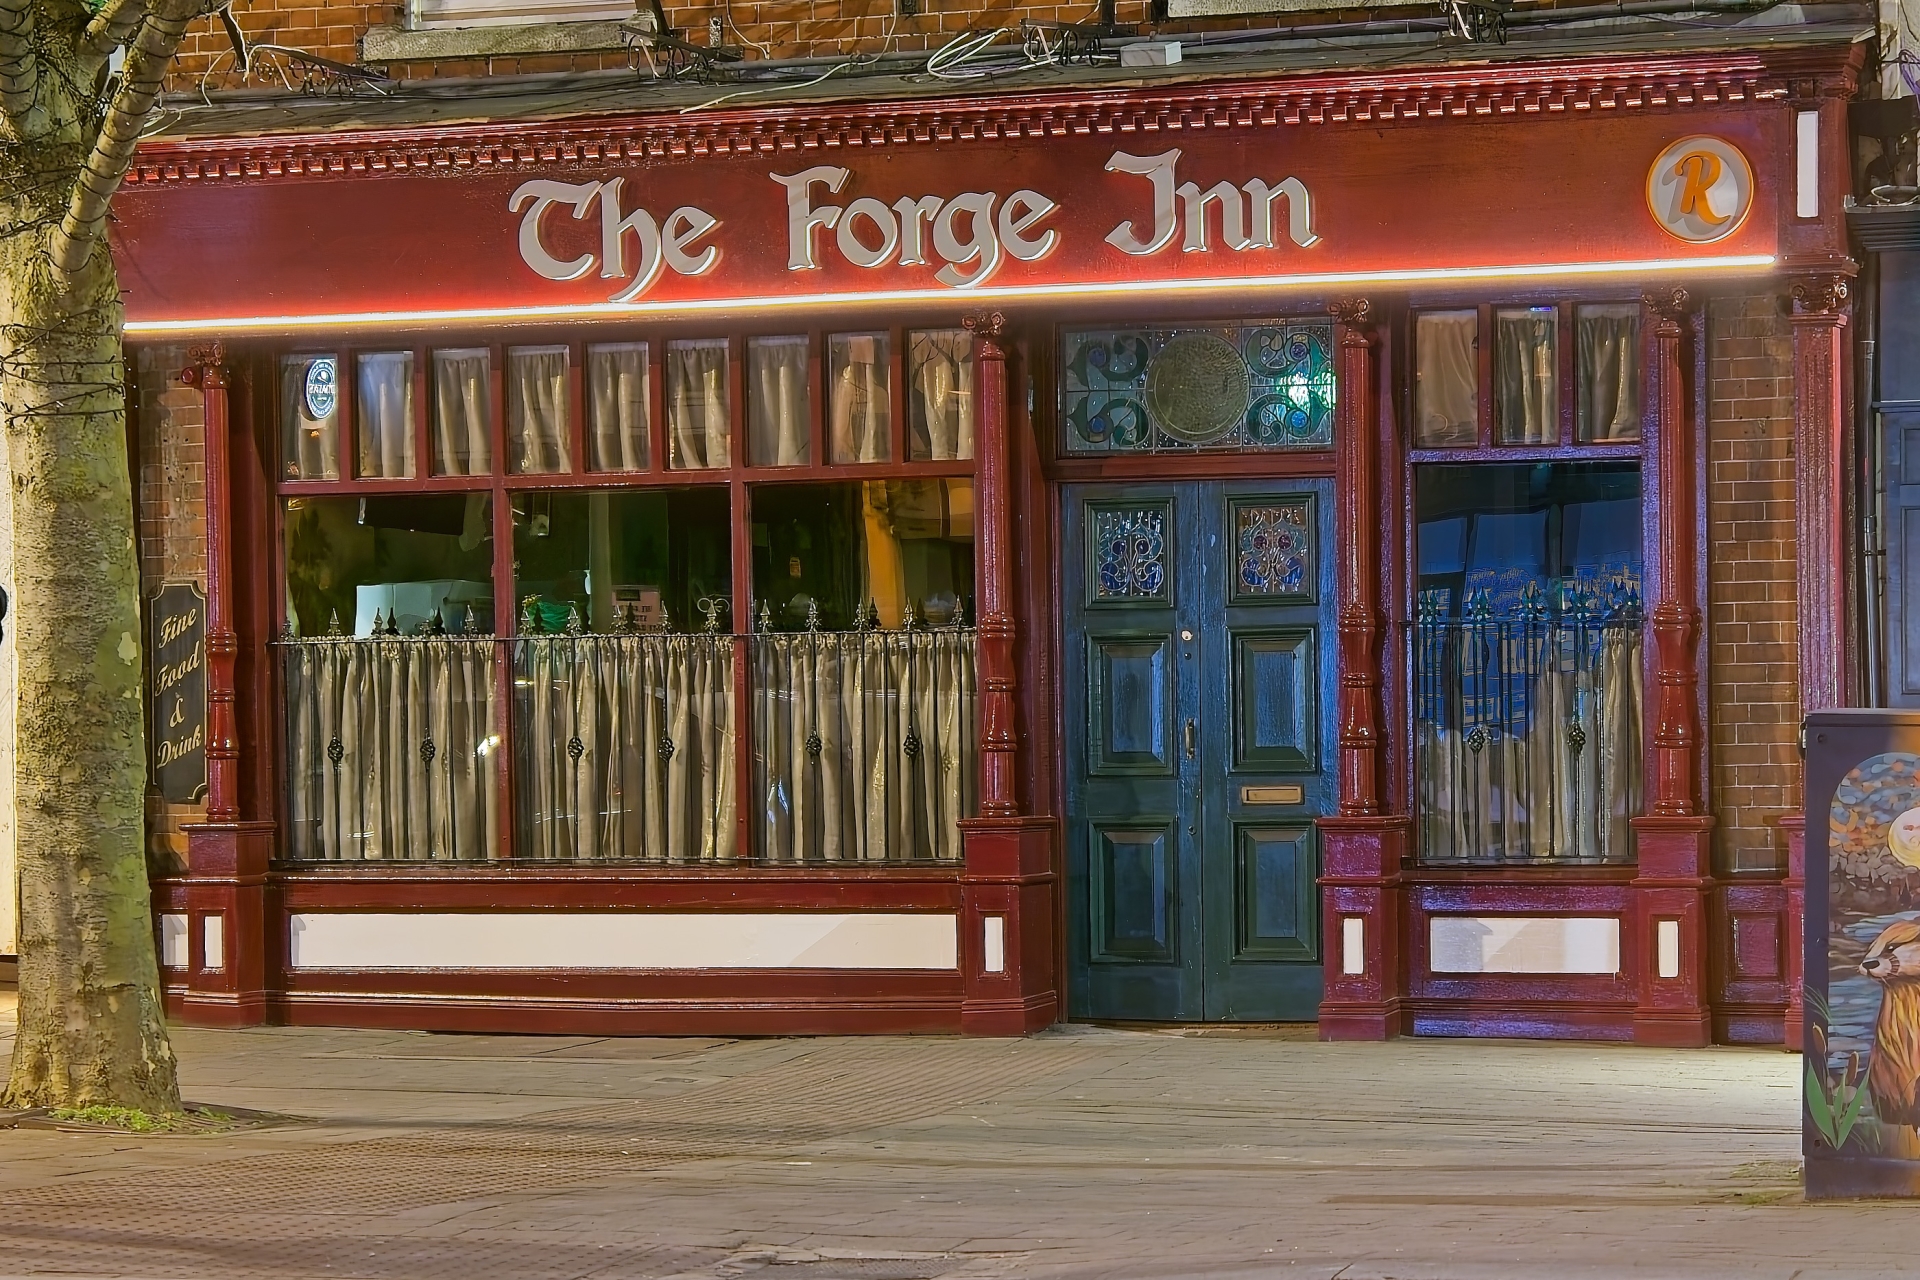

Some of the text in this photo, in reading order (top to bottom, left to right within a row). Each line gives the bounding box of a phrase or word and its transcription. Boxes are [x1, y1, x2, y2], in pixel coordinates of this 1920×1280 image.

[1674, 150, 1731, 226] R
[508, 147, 1318, 303] The Forge Inn
[158, 607, 197, 649] Fine
[155, 640, 200, 697] Food
[169, 697, 185, 728] &
[156, 724, 202, 770] Drink
